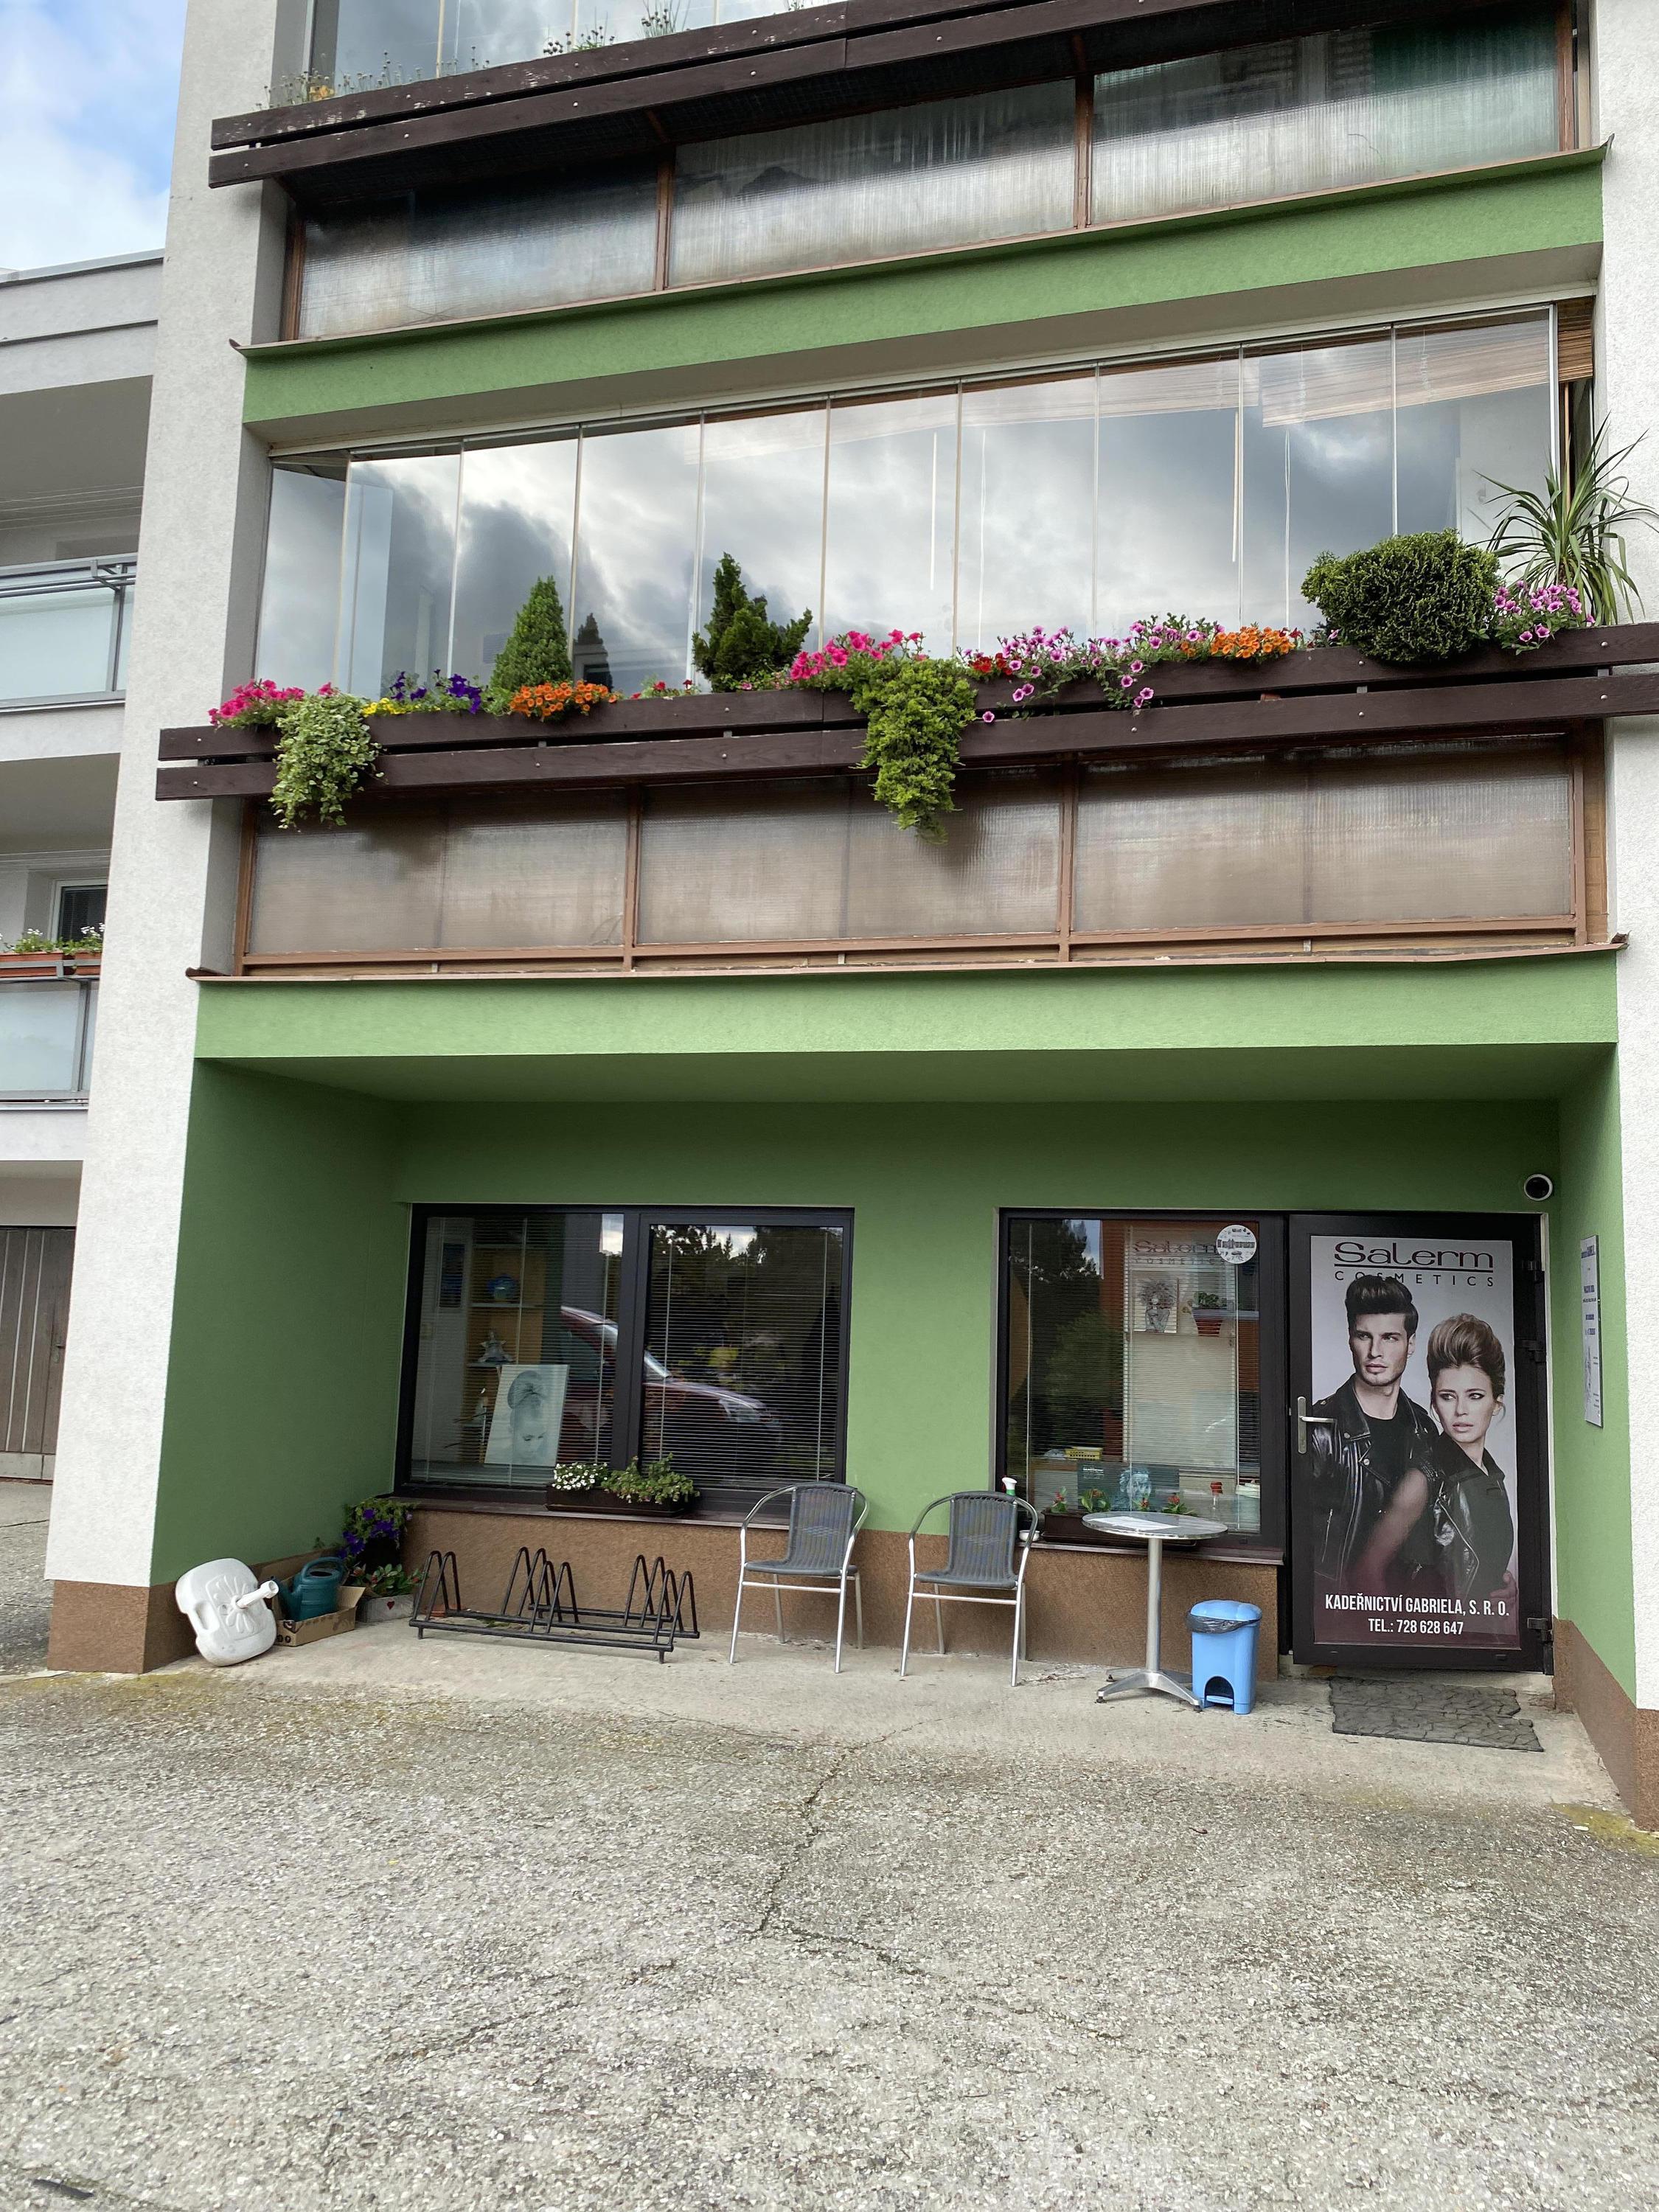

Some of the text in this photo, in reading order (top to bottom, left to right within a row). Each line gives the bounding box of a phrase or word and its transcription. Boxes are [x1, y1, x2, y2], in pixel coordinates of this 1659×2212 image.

[1334, 1242, 1493, 1268] Salerm
[1325, 1593, 1509, 1616] KADEŘNICTVÍ GABRIELA, S. R. O.
[1368, 1618, 1464, 1635] TEL.: 728 628 647
